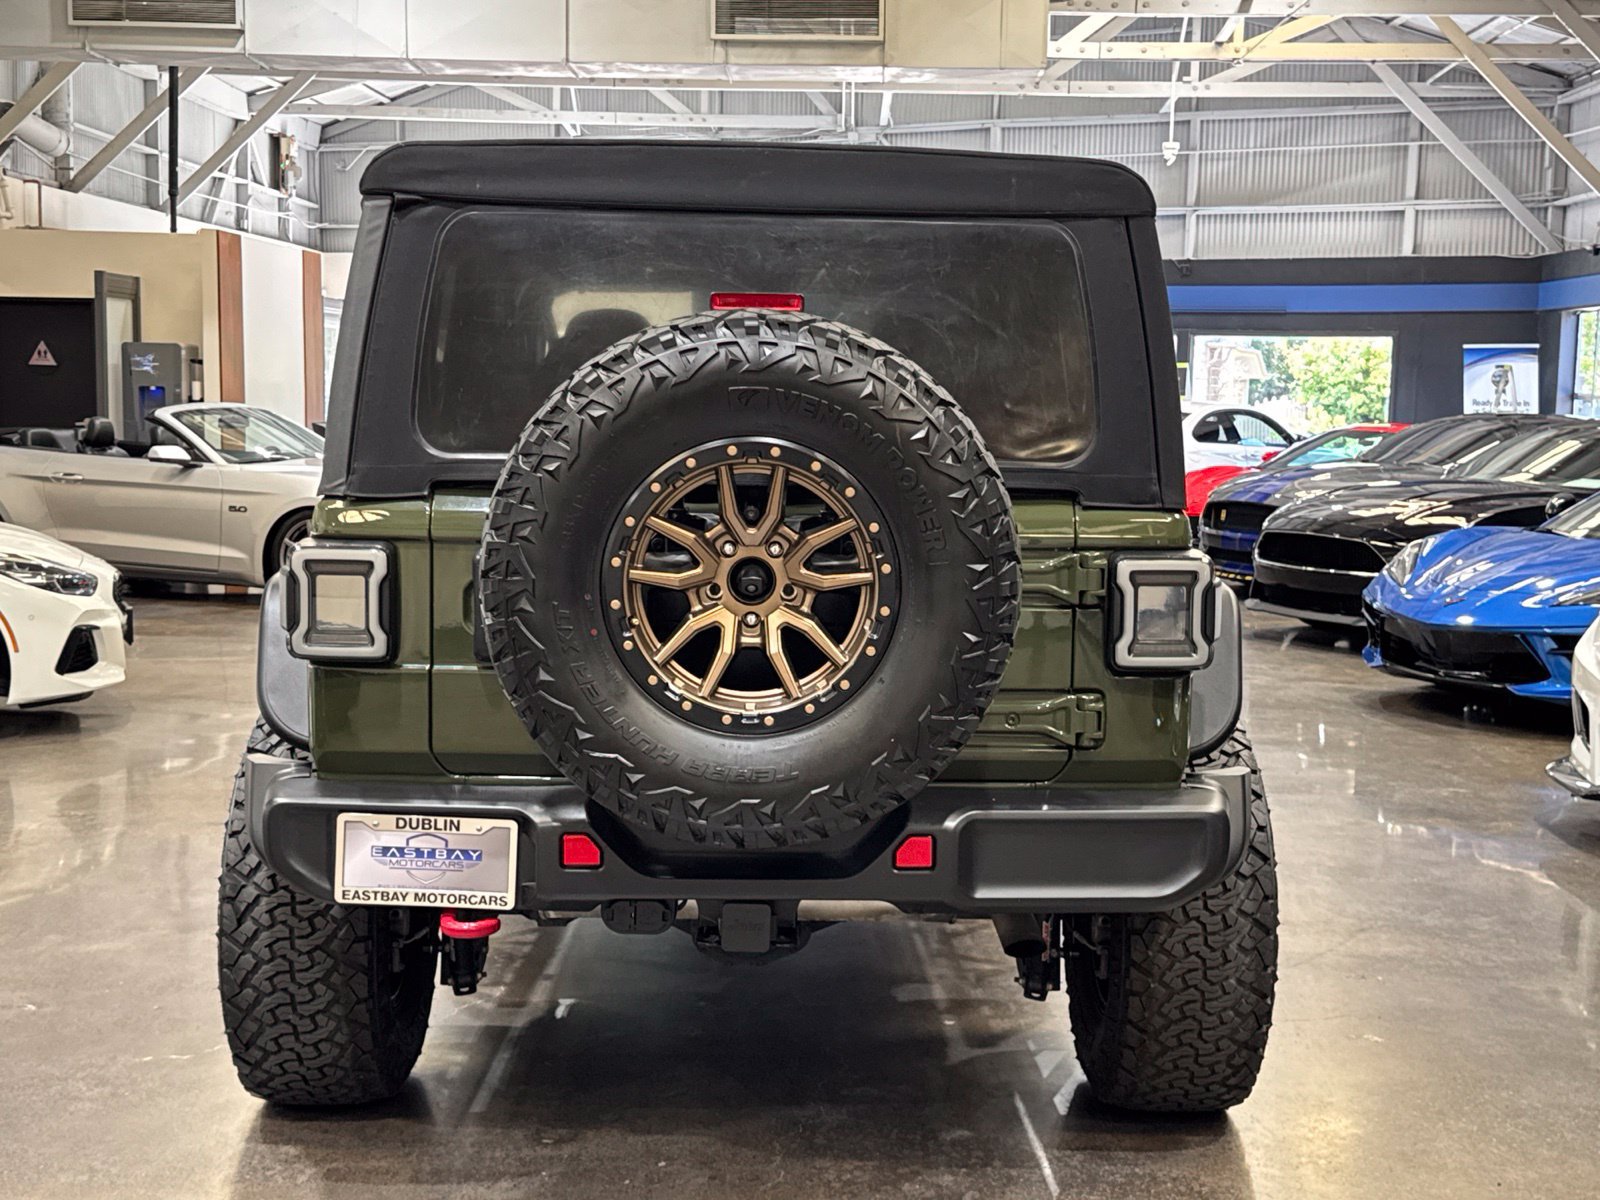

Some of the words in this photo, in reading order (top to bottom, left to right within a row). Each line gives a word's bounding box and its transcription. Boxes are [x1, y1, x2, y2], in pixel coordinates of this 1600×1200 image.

[776, 387, 886, 452] VENOM
[885, 445, 949, 554] POWER
[569, 661, 680, 767] HUNTER
[680, 757, 800, 783] TERRA
[395, 817, 461, 832] DUBLIN
[372, 846, 481, 860] EASTBAY
[388, 858, 465, 869] MOTORCARS
[341, 889, 409, 902] EASTBAY
[413, 892, 508, 907] MOTORCARS
